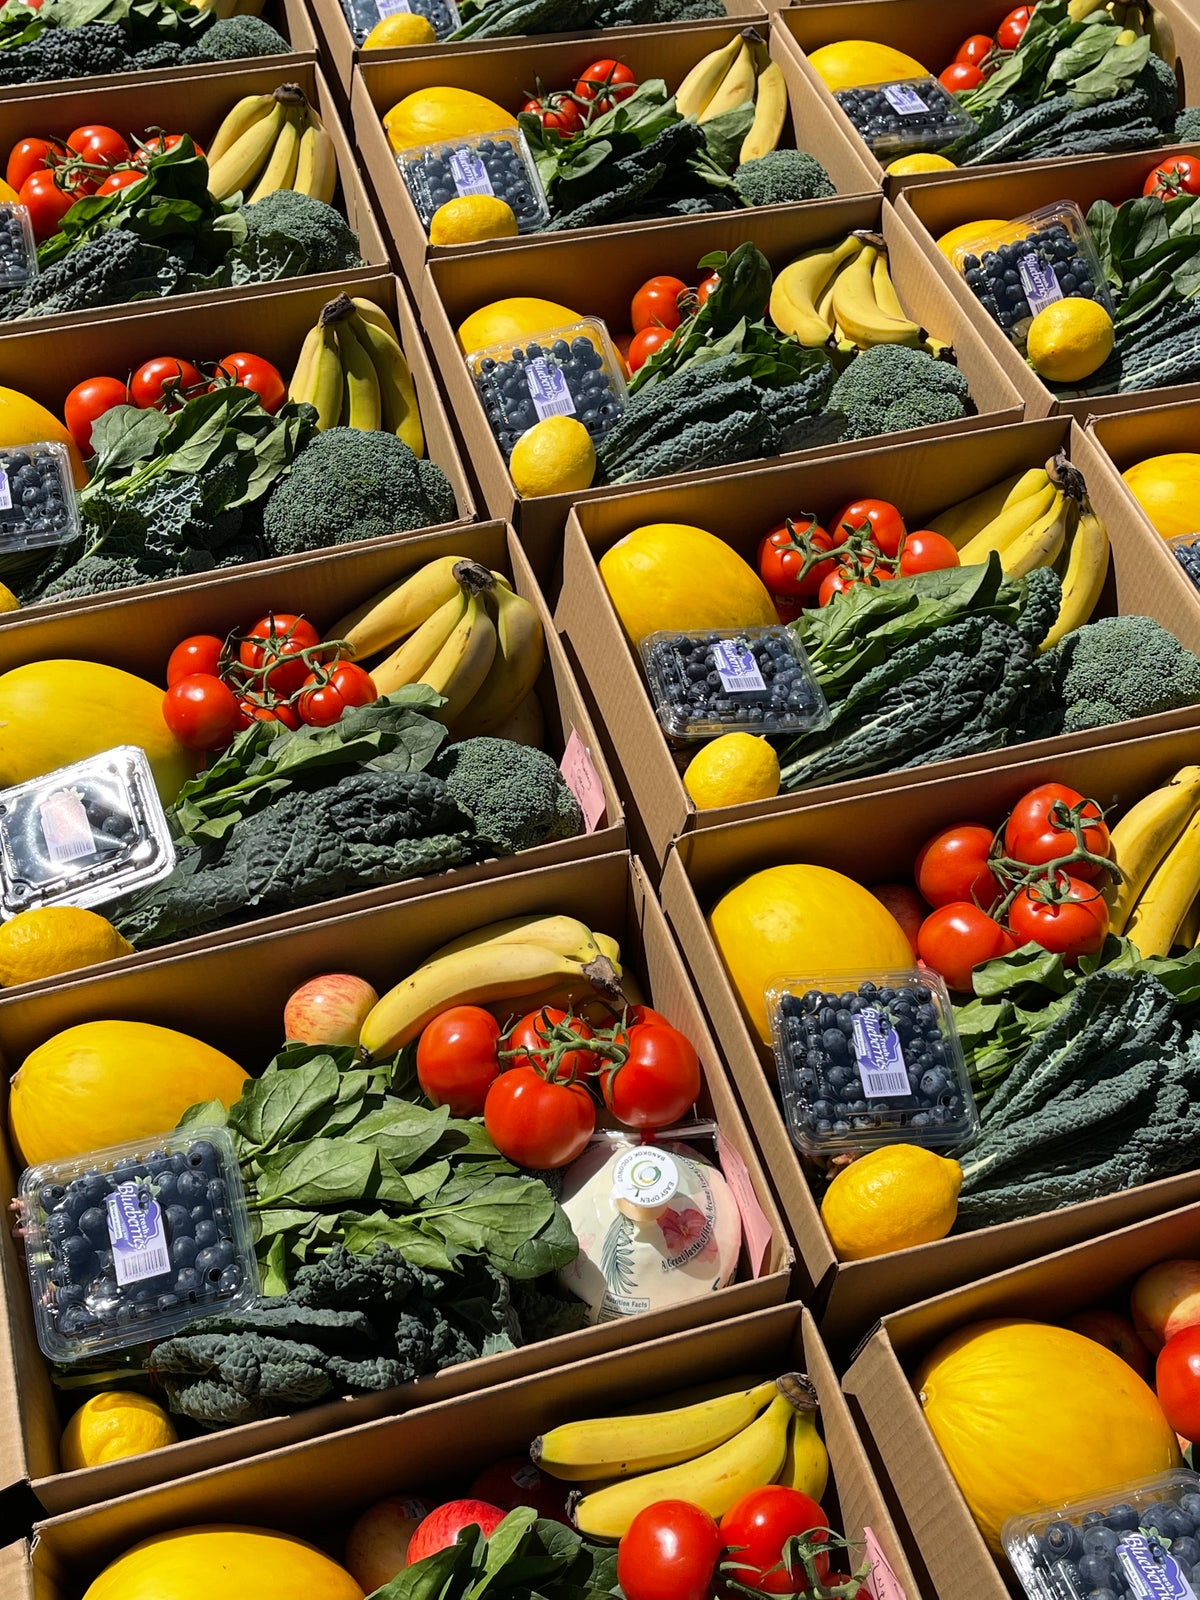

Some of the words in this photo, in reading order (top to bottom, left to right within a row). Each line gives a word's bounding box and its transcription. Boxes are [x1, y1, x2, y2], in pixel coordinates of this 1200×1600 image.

[860, 1008, 886, 1070] Blueberries
[634, 1151, 666, 1161] BANGKOK
[617, 1155, 633, 1182] COCONUT
[639, 1194, 660, 1203] OPEN
[660, 1181, 675, 1198] EASY
[117, 1185, 146, 1250] Blueberries
[632, 1300, 647, 1308] Facts
[1123, 1537, 1173, 1600] Blueberrie
[1157, 1569, 1175, 1592] Fresh
